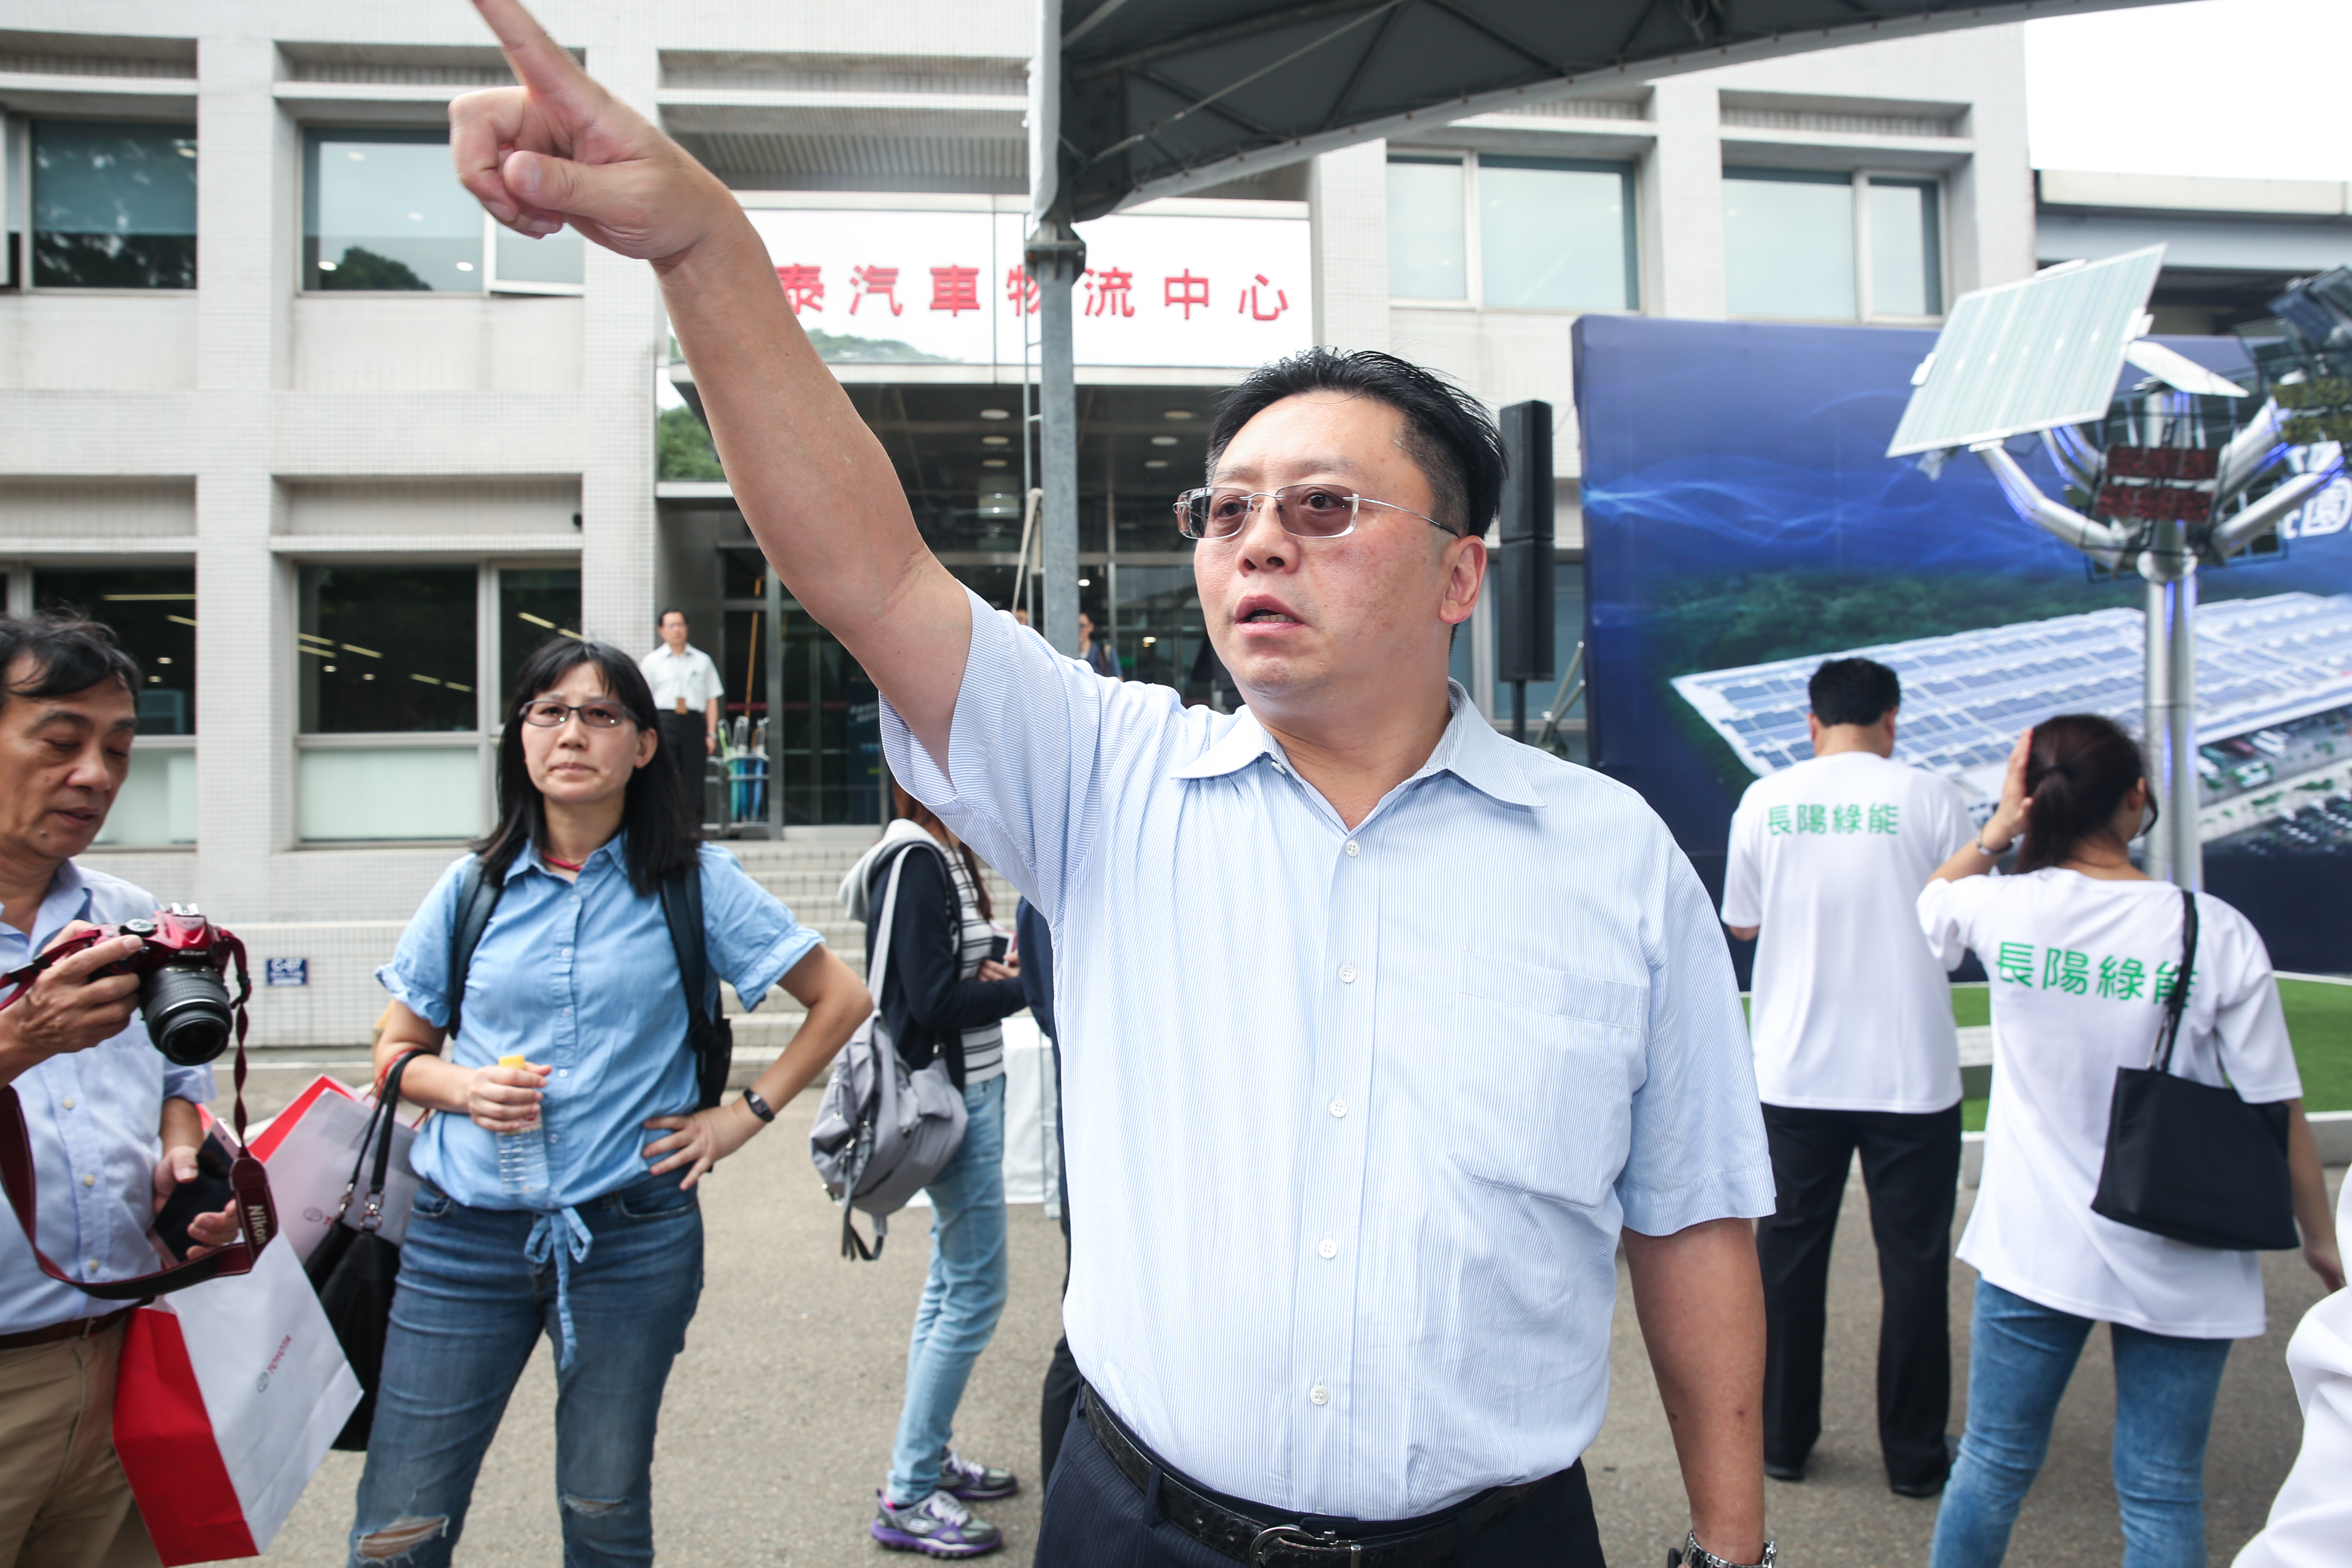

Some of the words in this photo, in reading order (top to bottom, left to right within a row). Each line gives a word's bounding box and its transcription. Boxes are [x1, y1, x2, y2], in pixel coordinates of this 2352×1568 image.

[1768, 803, 1900, 835] 長陽綠能
[247, 1205, 267, 1245] Nikon
